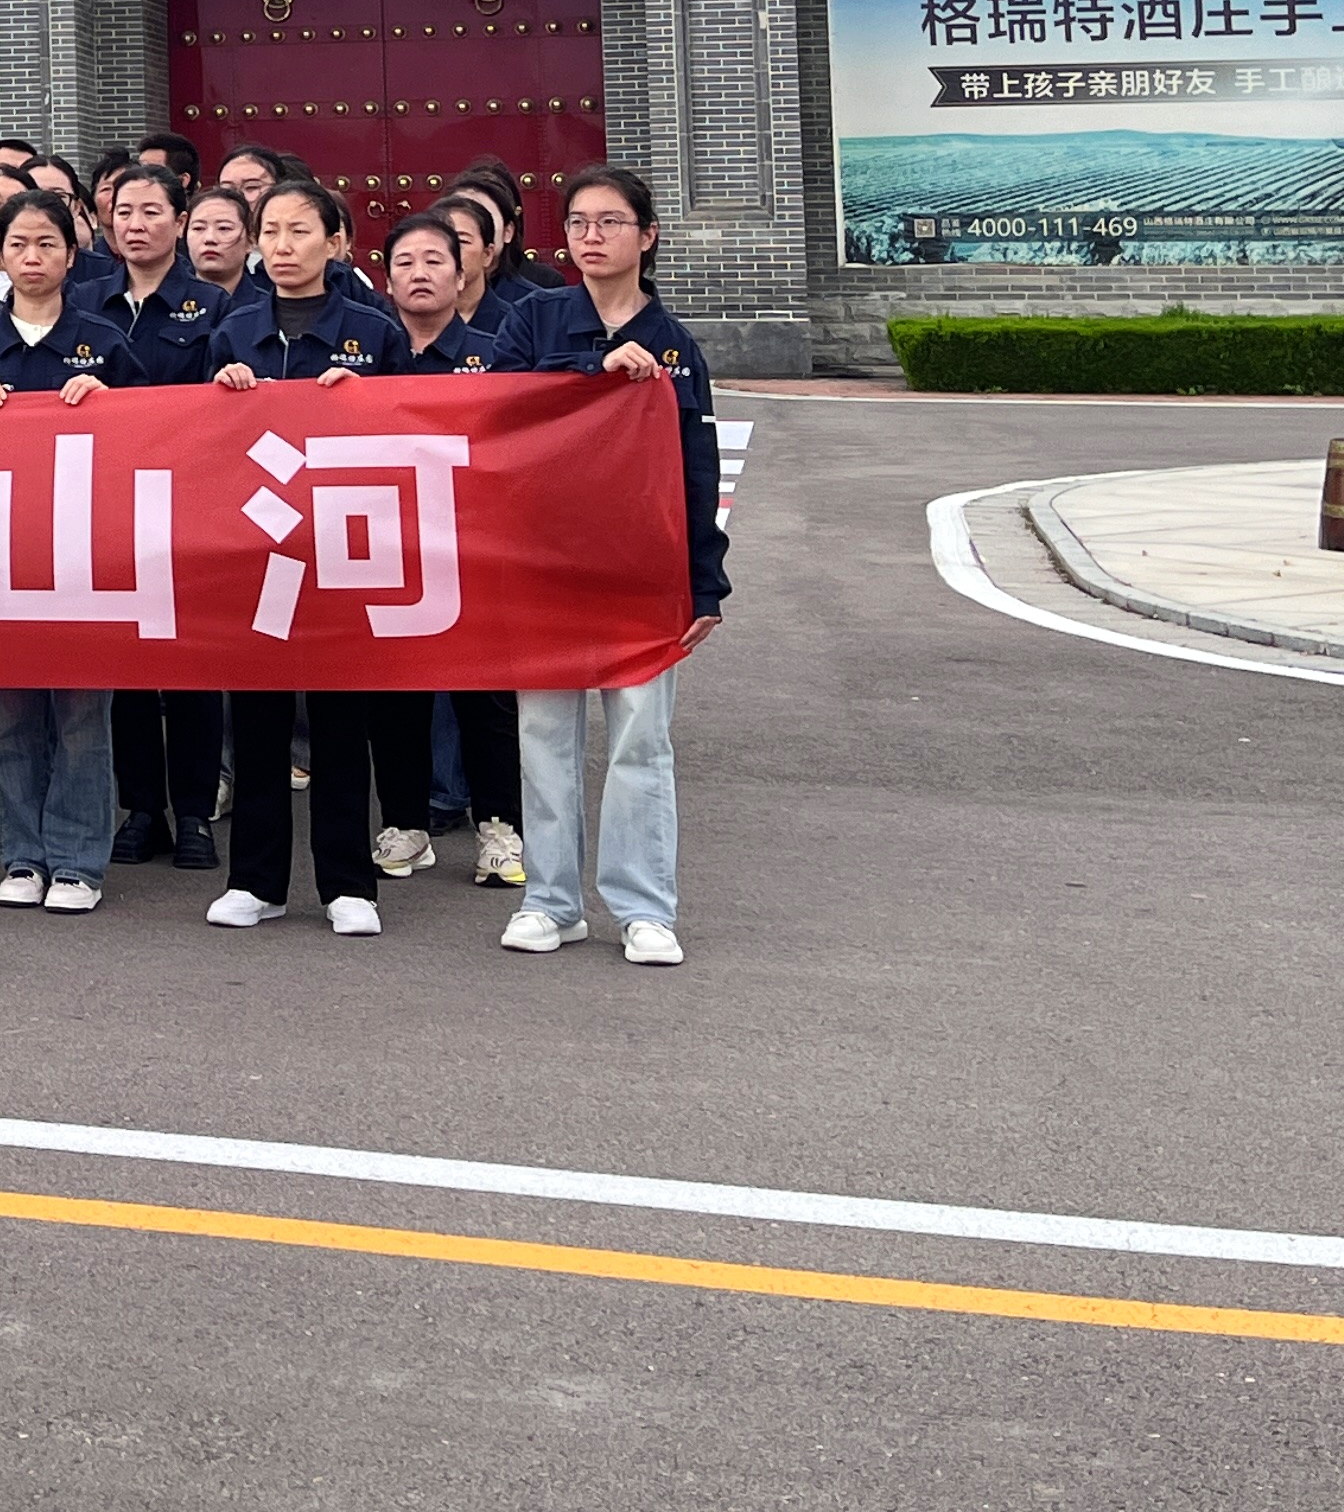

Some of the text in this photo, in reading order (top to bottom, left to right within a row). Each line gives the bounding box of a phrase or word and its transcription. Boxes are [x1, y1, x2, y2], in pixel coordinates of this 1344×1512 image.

[960, 68, 1217, 100] 带上孩子亲朋好友
[967, 217, 1138, 237] 4000-111-469
